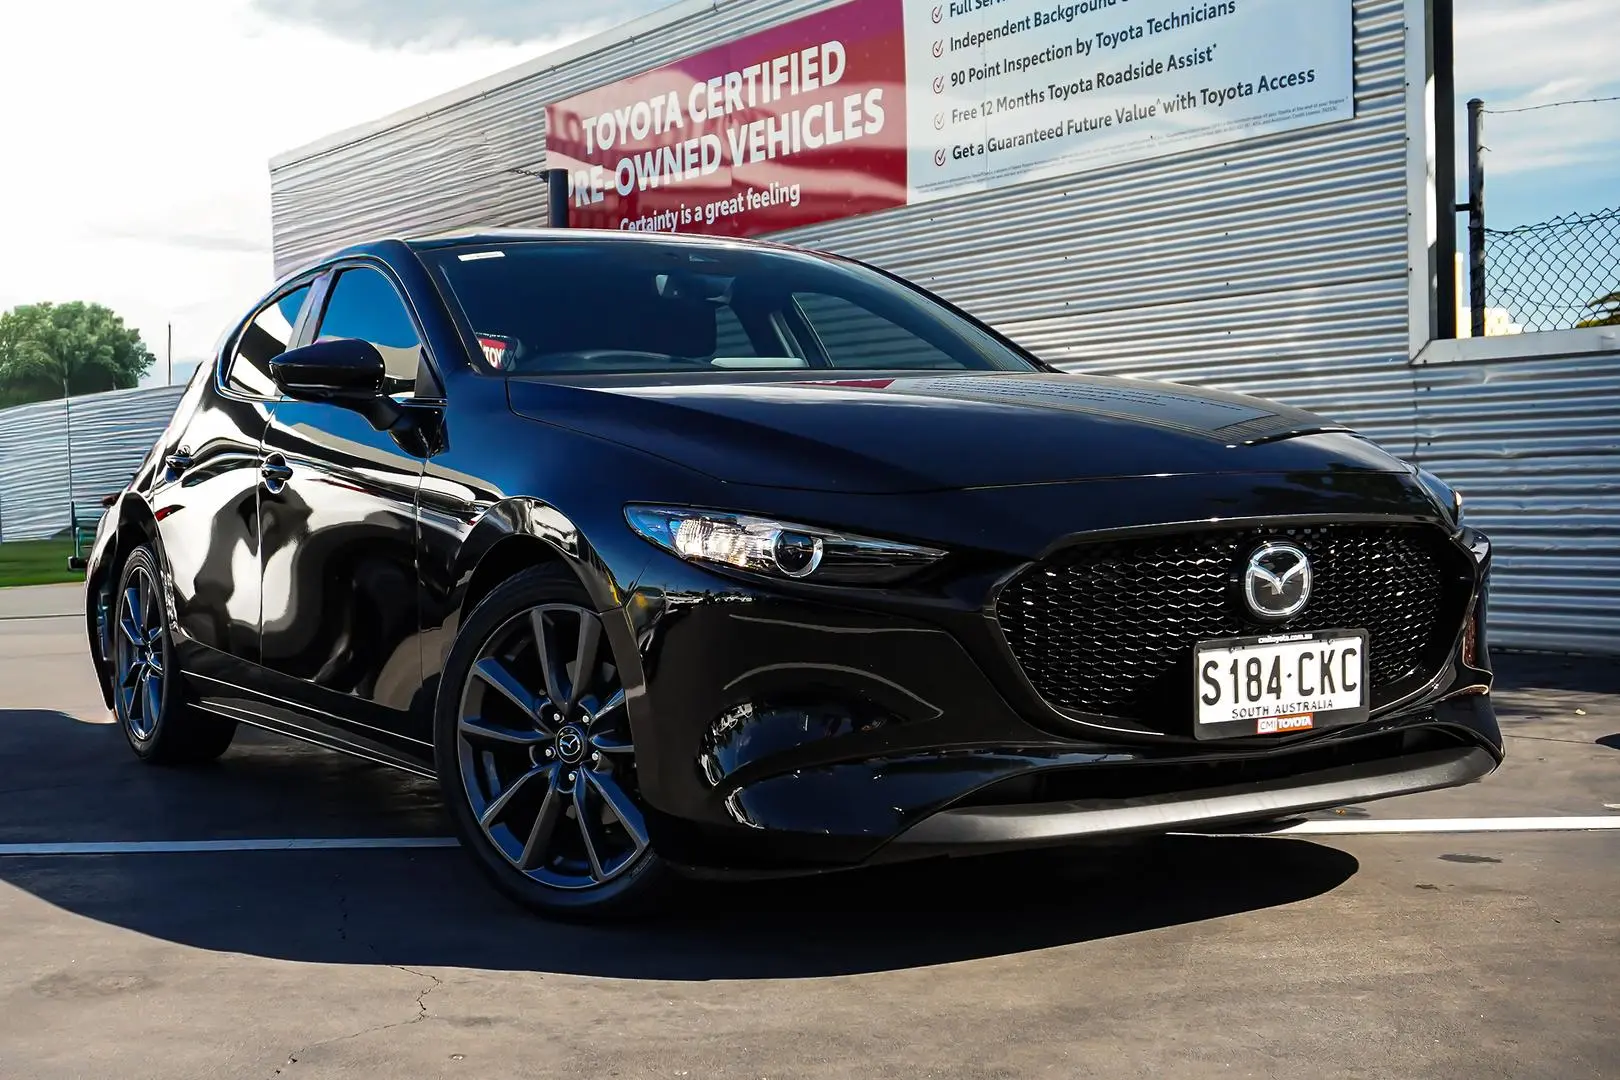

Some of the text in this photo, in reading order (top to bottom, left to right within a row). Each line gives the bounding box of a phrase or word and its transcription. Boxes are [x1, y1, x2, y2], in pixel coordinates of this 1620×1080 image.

[950, 0, 972, 17] Full
[950, 16, 1031, 51] Independent
[951, 0, 1236, 87] 90 Point Inspection by Toyota Technicians
[582, 40, 846, 155] TOYOTA CERTIFIED
[952, 105, 977, 124] Free
[980, 102, 993, 117] 12
[996, 88, 1045, 113] Months
[1048, 77, 1093, 101] Toyota
[1097, 59, 1163, 88] Roadside
[952, 143, 975, 160] Get
[977, 142, 985, 155] a
[987, 121, 1064, 152] Guaranteed
[1067, 111, 1112, 135] Future
[1163, 92, 1197, 114] with
[1200, 81, 1253, 108] Toyota
[1257, 69, 1315, 93] Access
[728, 88, 885, 167] VEHICLES
[620, 183, 800, 233] Certainty is a great feeling
[1232, 699, 1333, 719] SOUTH AUSTRALIA
[1277, 715, 1312, 729] TOYOTA
